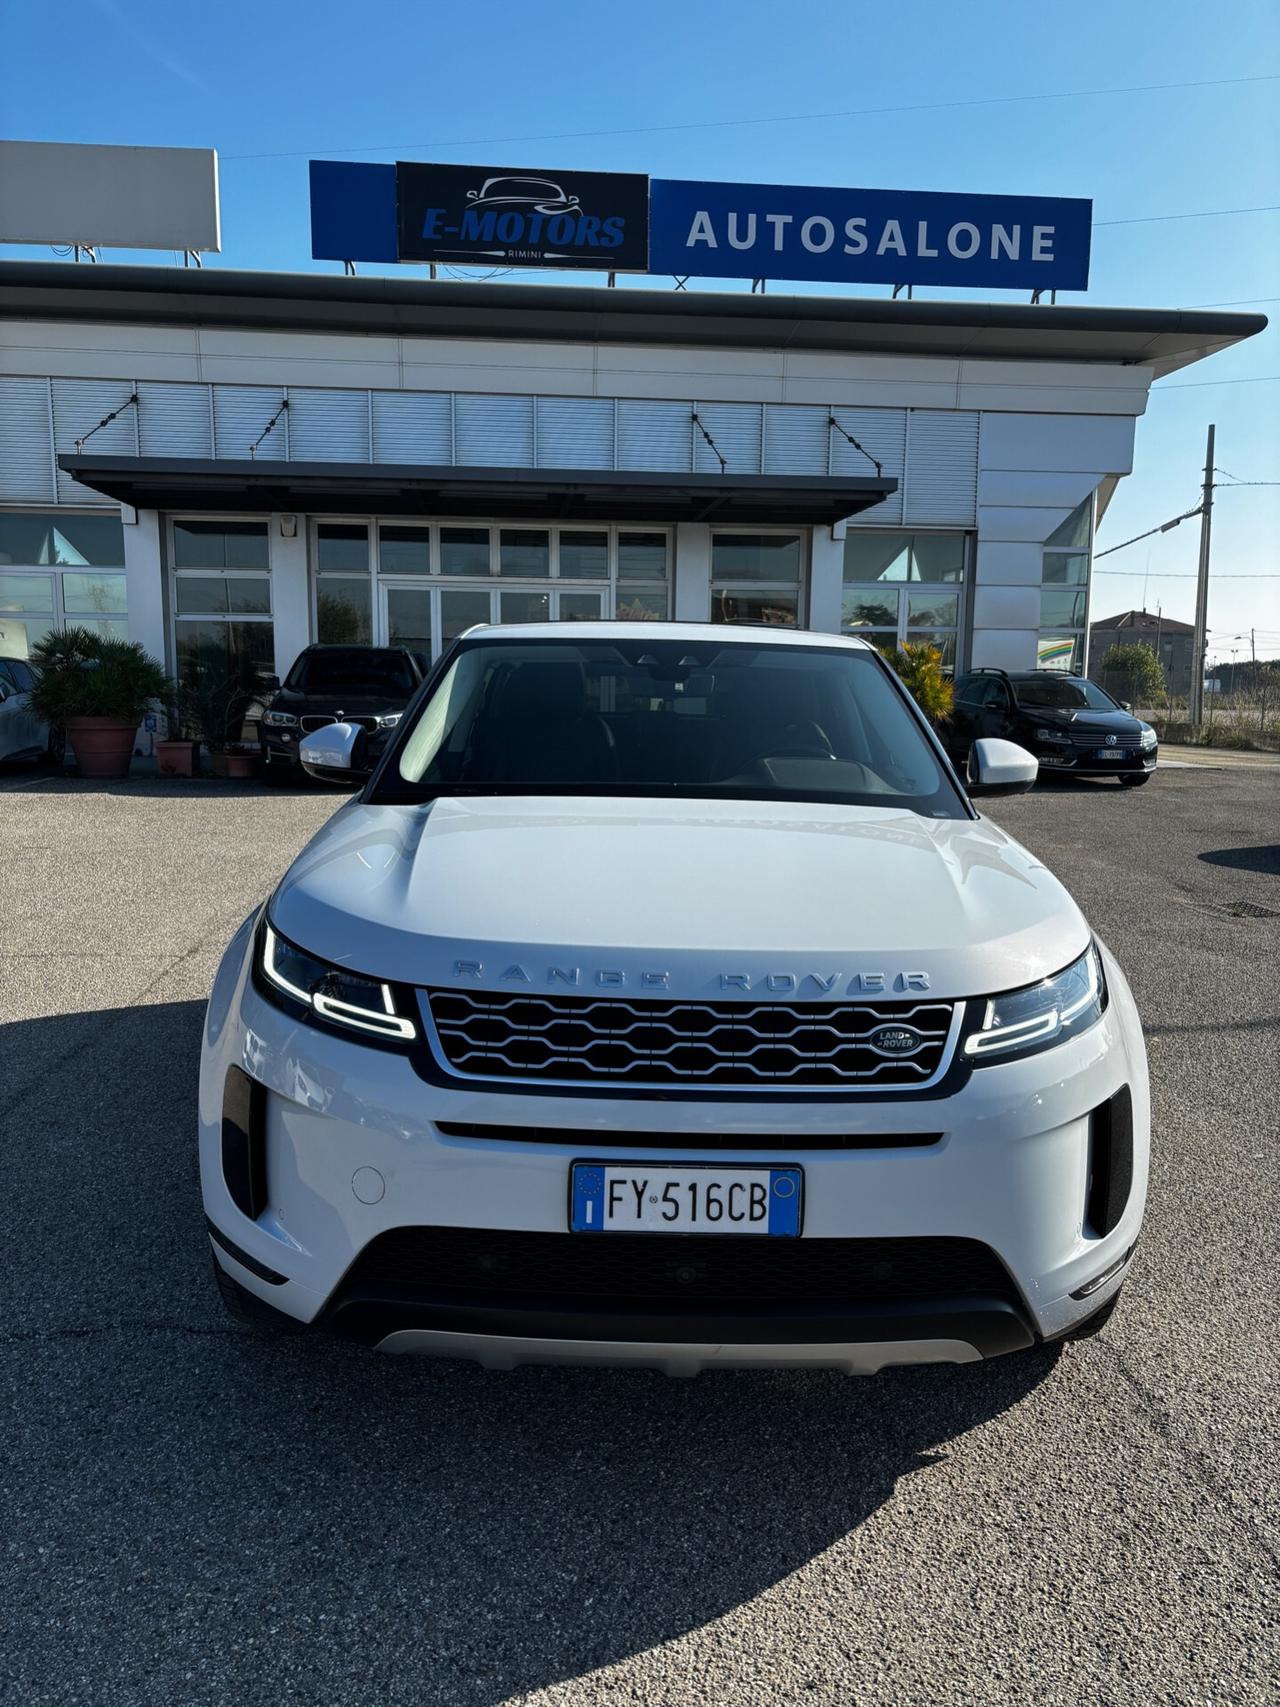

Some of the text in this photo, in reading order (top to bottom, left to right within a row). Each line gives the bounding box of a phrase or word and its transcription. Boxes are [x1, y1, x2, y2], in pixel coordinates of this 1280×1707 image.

[422, 207, 625, 247] E-MOTORS
[685, 210, 1056, 262] AUTOSALONE
[507, 249, 543, 260] RIMINI
[452, 958, 932, 992] RANGE ROVER
[880, 1031, 905, 1040] LAND
[882, 1039, 914, 1048] ROVER
